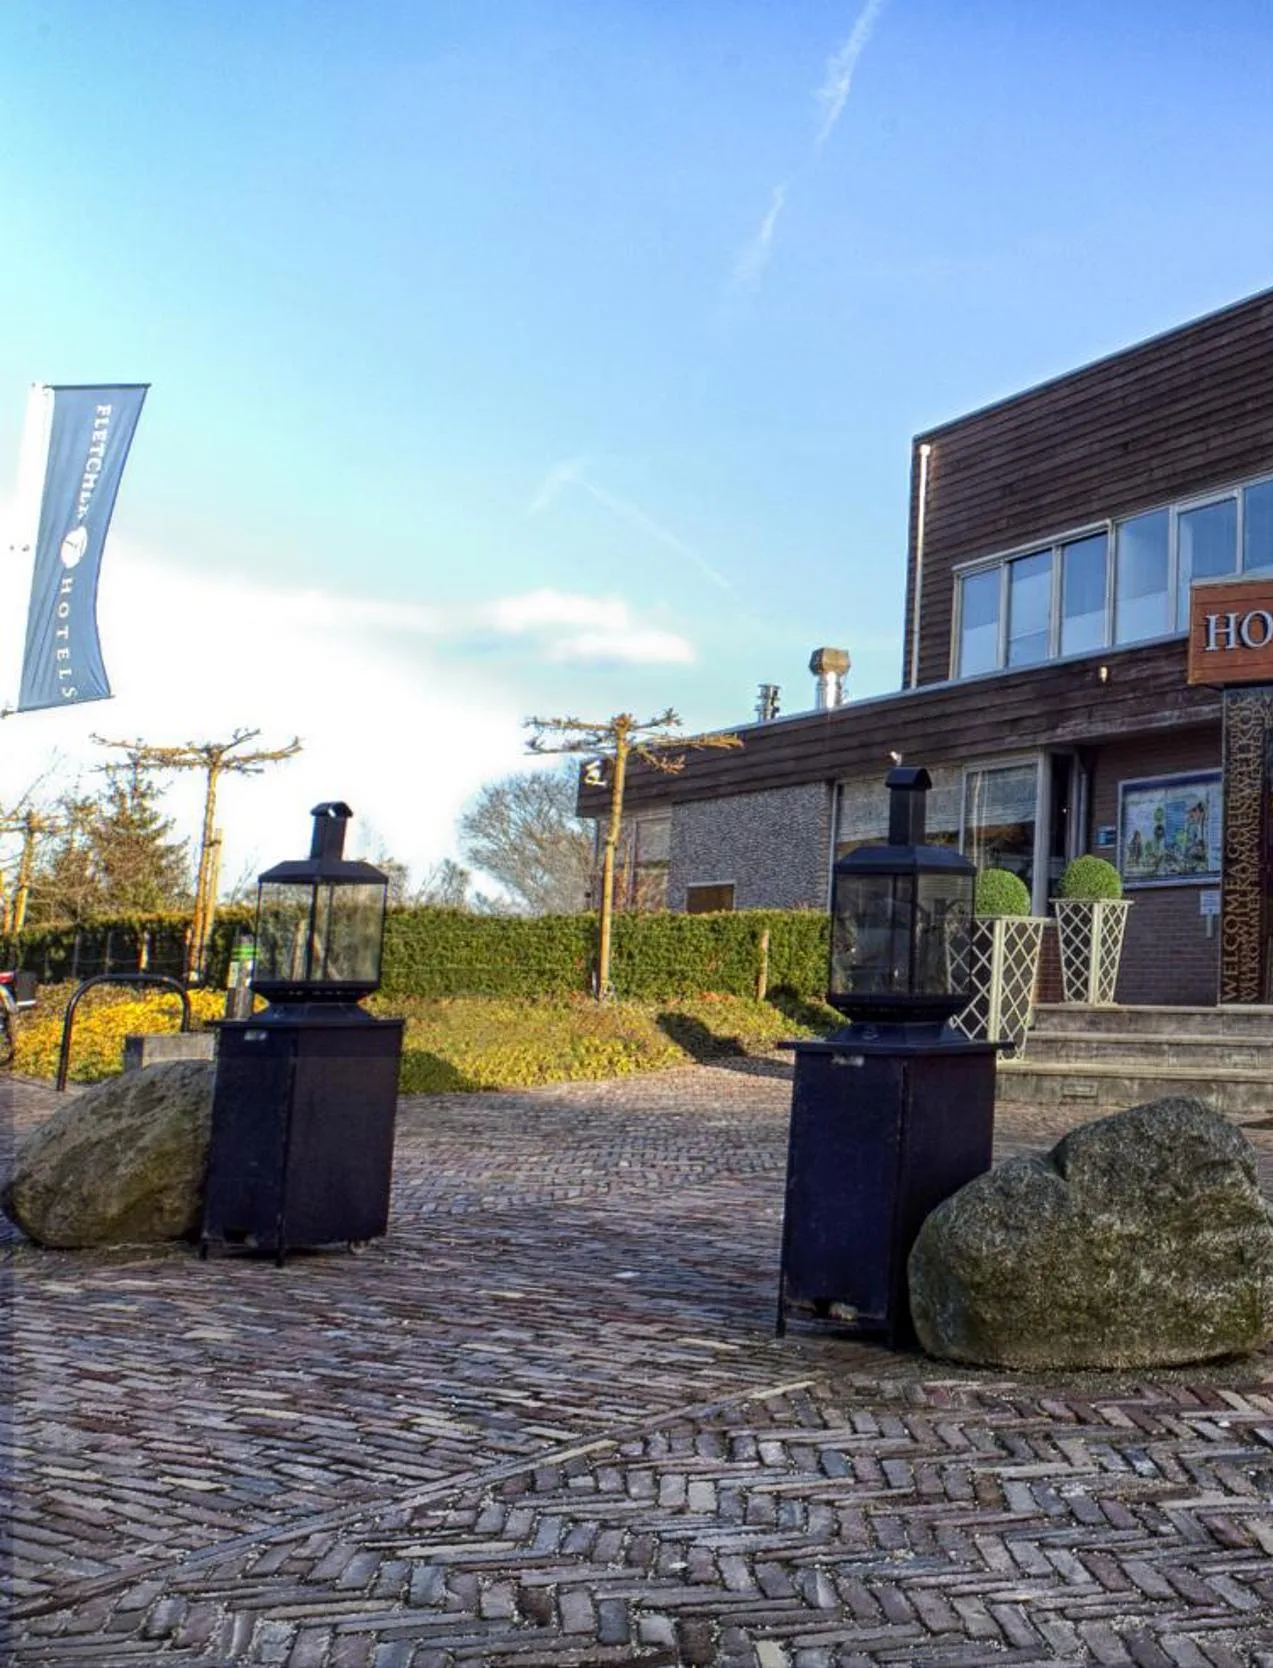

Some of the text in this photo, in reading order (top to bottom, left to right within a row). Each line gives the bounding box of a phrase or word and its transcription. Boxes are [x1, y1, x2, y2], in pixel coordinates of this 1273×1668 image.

[76, 403, 112, 519] FLETCHER
[56, 576, 77, 699] HOTELS
[1222, 878, 1239, 1001] WELCOME
